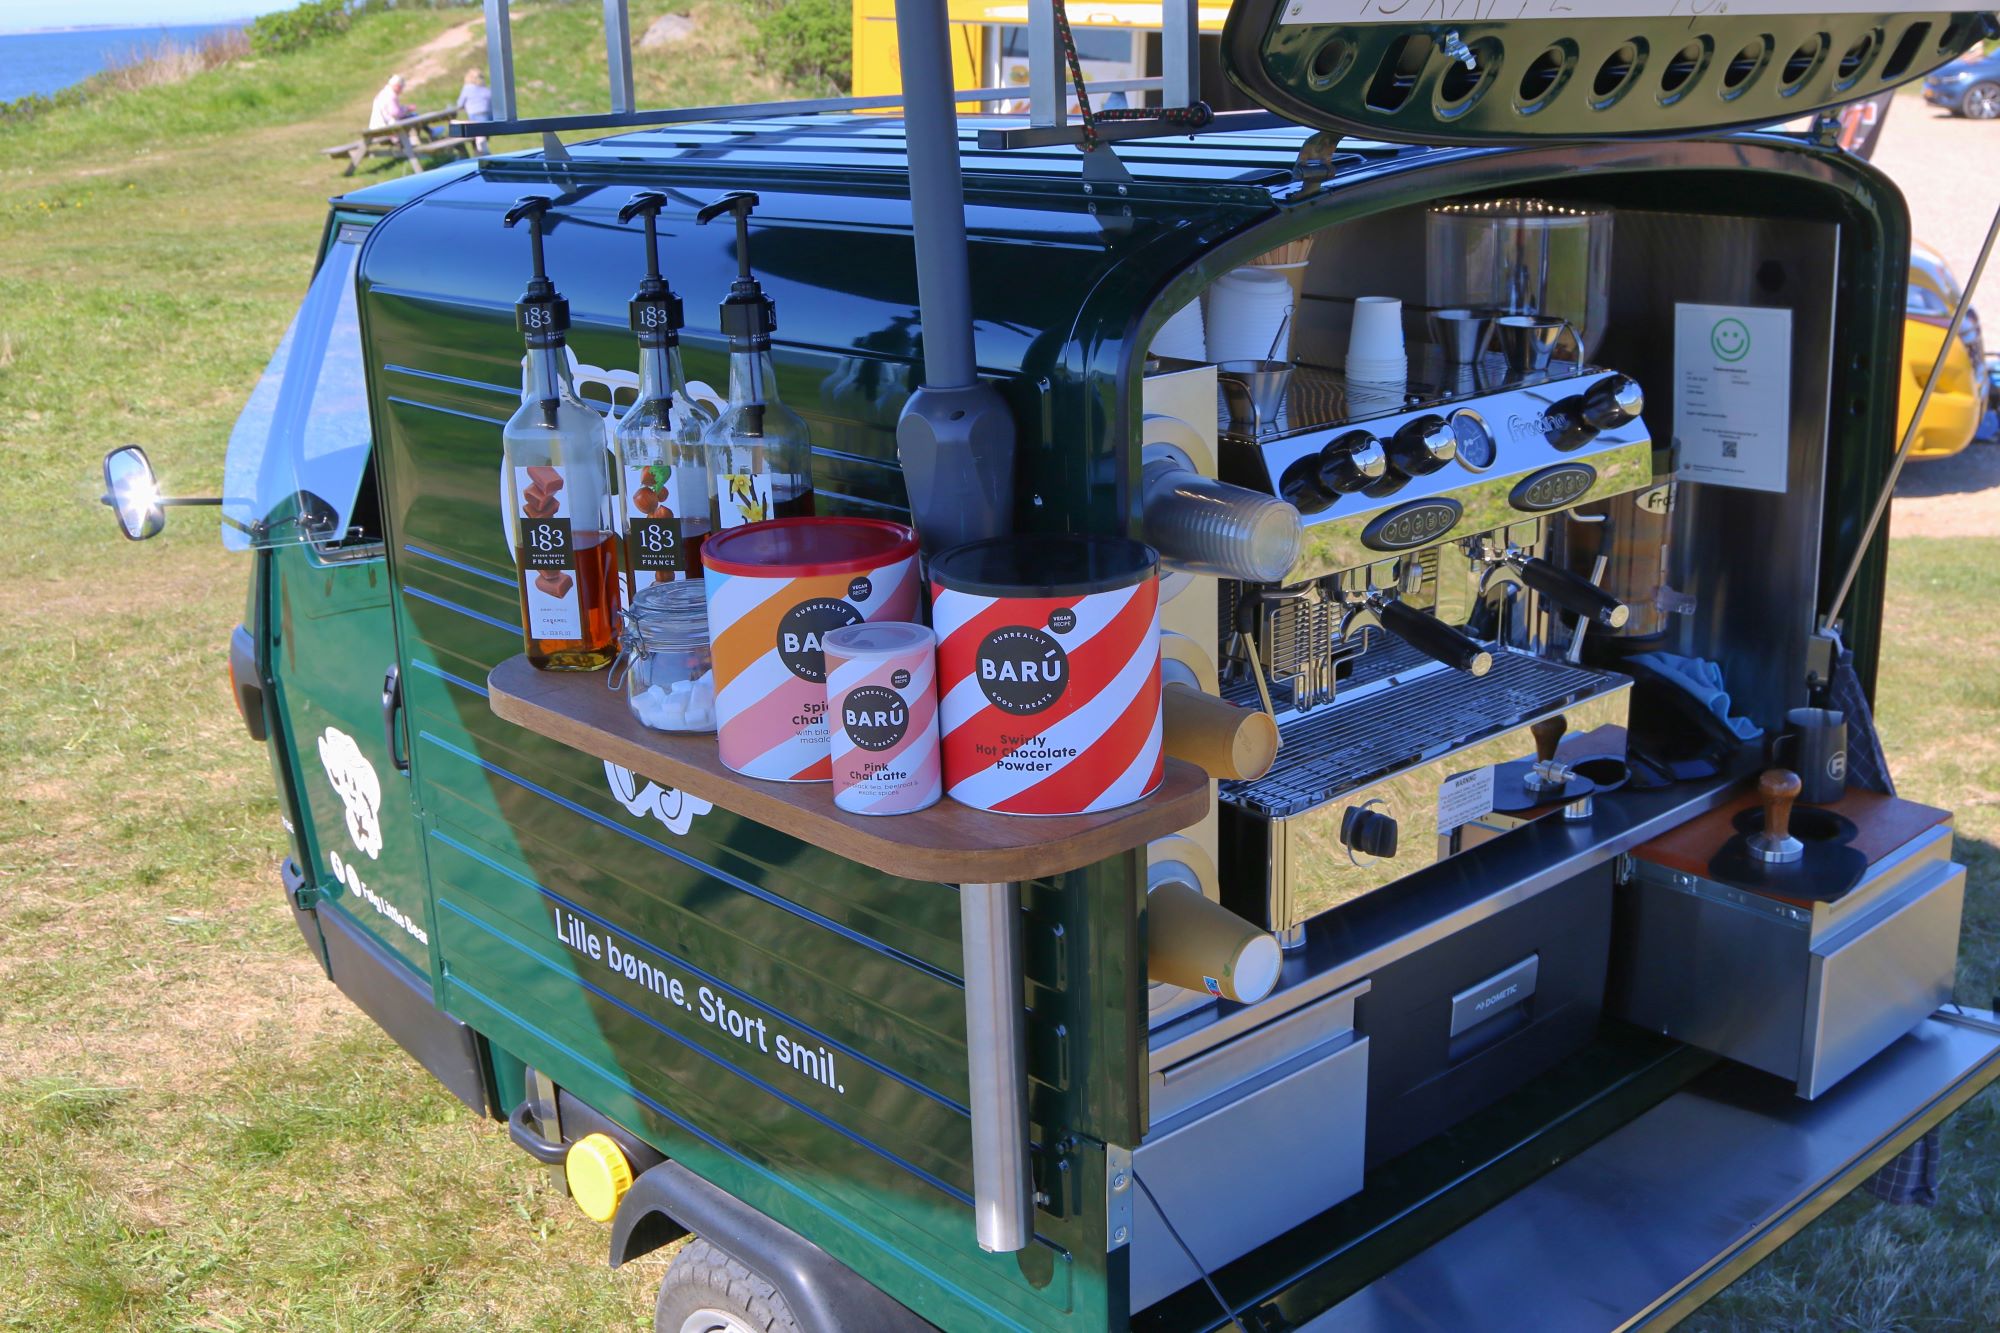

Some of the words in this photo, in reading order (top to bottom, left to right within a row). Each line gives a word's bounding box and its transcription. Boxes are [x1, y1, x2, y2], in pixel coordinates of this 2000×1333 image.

[795, 603, 847, 618] SURREALLY
[993, 632, 1046, 645] SURREALLY
[795, 663, 818, 677] GOOD
[981, 648, 1061, 682] BARÚ
[853, 690, 893, 700] SURREALLY
[992, 691, 1013, 708] GOOD
[1019, 693, 1052, 710] TREATS
[803, 701, 829, 714] Spi
[845, 701, 904, 727] BARÚ
[792, 713, 824, 726] Chai
[796, 728, 813, 737] with
[815, 727, 831, 736] bla
[873, 733, 898, 748] TREATS
[1000, 734, 1047, 749] Swirly
[975, 743, 998, 757] Hot
[1001, 747, 1077, 759] Chocolate
[864, 762, 889, 772] Pink
[996, 760, 1053, 772] Powder
[849, 771, 873, 781] Chai
[876, 771, 907, 781] Latte
[554, 907, 601, 960] Lille
[606, 935, 692, 1012] bønne.
[698, 986, 768, 1053] Stort
[775, 1034, 845, 1094] smil.
